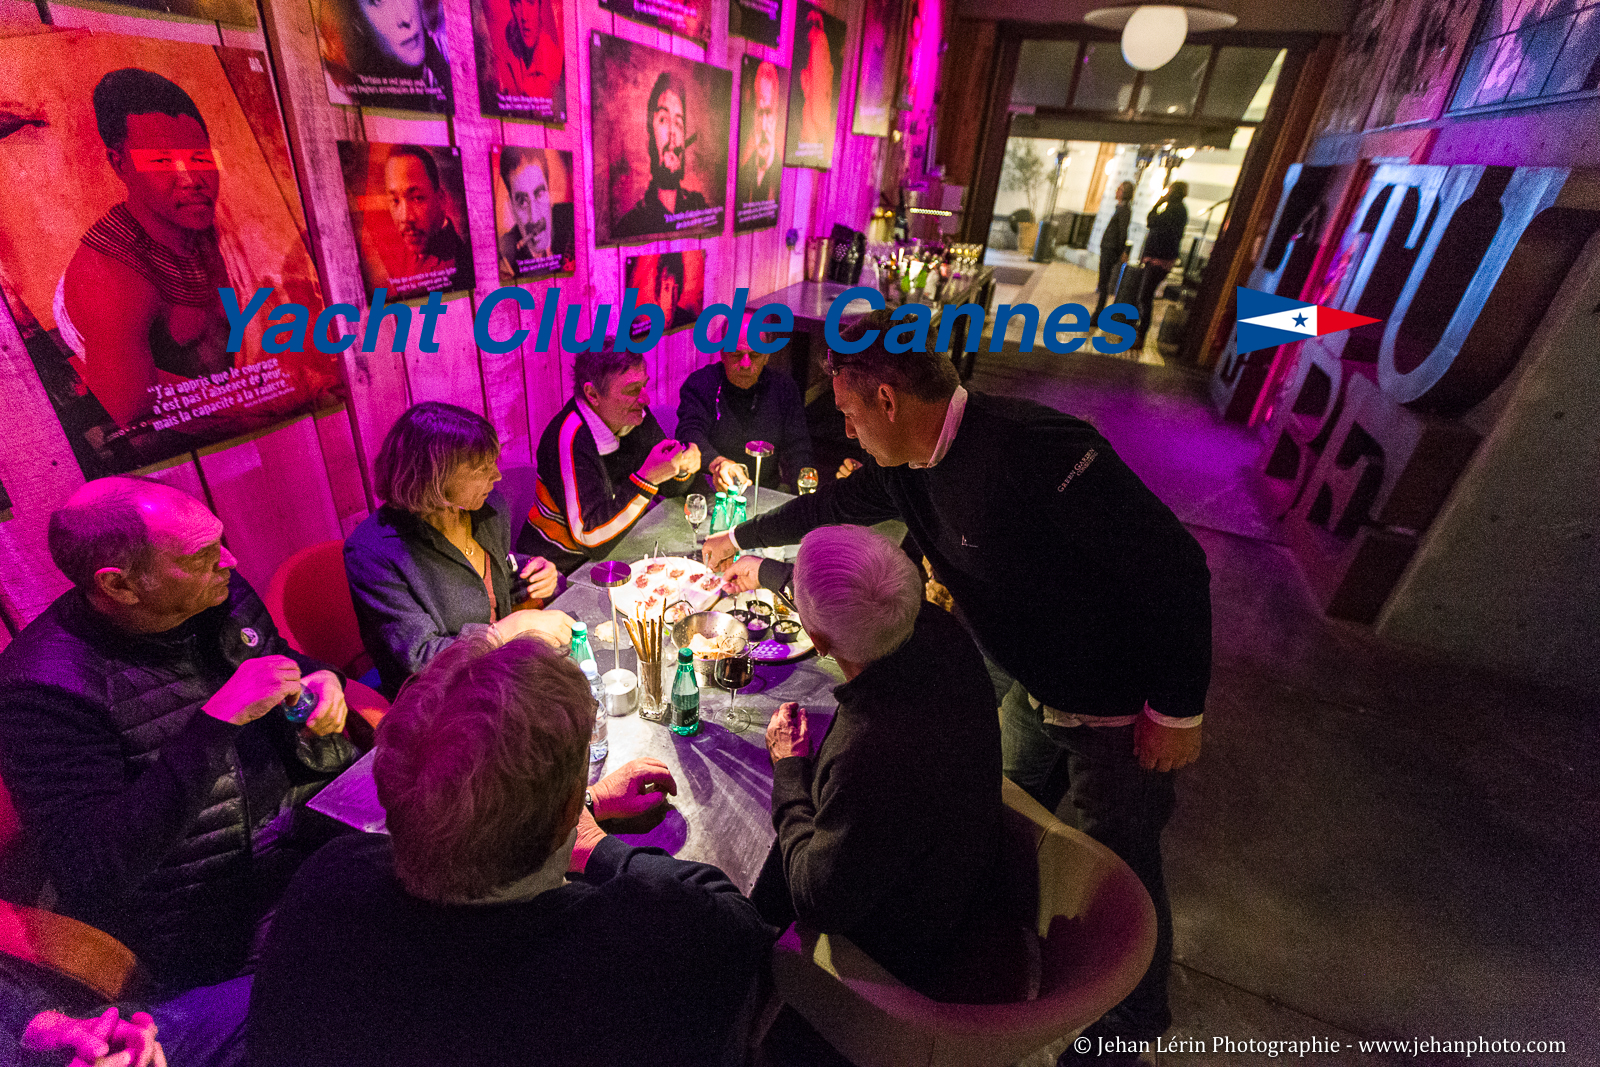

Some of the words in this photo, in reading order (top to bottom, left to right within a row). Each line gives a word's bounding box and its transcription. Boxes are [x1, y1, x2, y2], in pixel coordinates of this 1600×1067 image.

[176, 375, 210, 395] appris
[210, 371, 230, 387] que
[230, 366, 241, 379] le
[241, 358, 279, 374] courage
[182, 391, 202, 408] pas
[248, 373, 261, 385] de
[152, 415, 180, 432] mais
[178, 409, 192, 423] la
[192, 395, 236, 418] capacité
[244, 387, 255, 401] la
